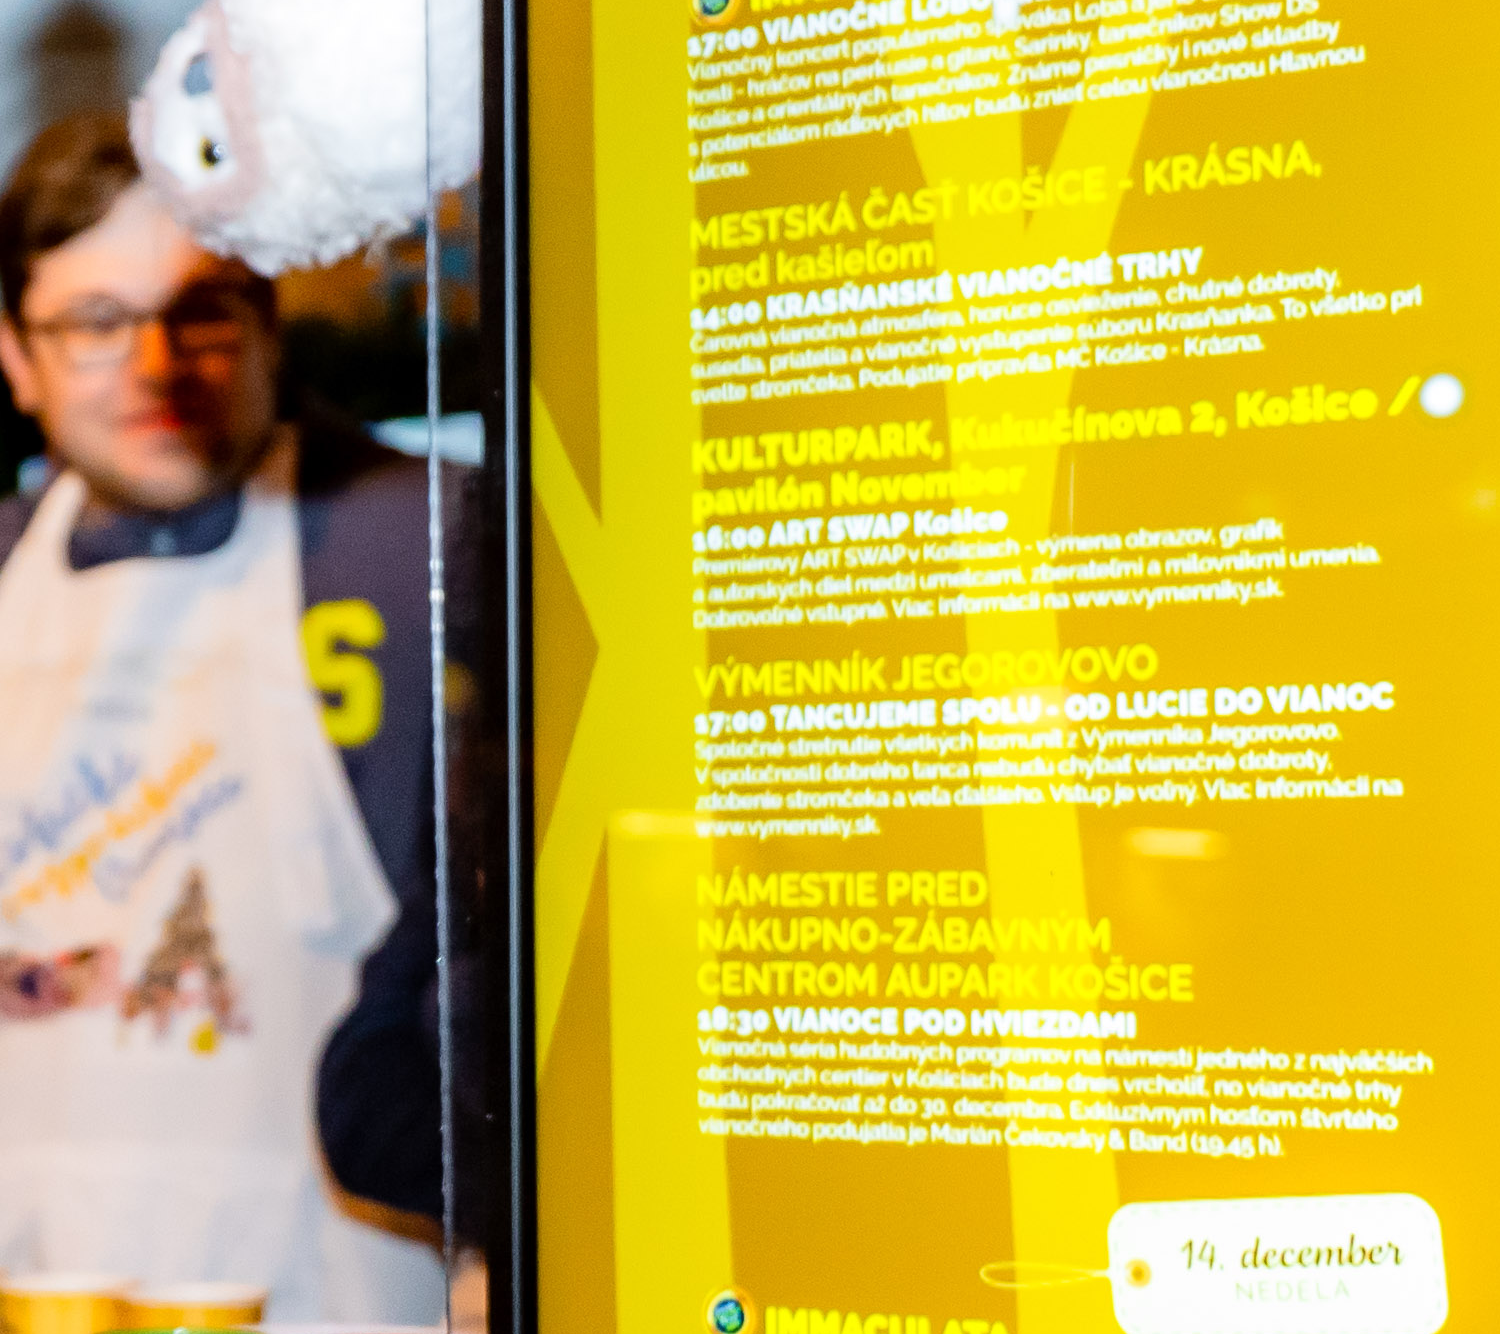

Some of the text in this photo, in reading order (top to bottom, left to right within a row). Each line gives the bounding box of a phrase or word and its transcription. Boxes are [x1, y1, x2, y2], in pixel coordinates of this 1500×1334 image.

[686, 26, 759, 57] 17:00
[691, 194, 848, 250] MESTSKÁ
[861, 180, 955, 229] ČASŤ
[969, 166, 1107, 214] KOŠICE
[1146, 141, 1320, 193] KRÁSNA,
[689, 247, 1203, 335] 14:00 KRASŇANSKÉ VIANOČNÉ TRHY
[690, 240, 933, 302] pred kašieľom
[691, 421, 944, 473] KULTURPARK,
[948, 407, 1183, 451] Kukučínova
[1190, 400, 1228, 437] 2,
[1236, 385, 1379, 428] Košice
[692, 463, 1026, 525] pavilón November
[692, 507, 1008, 552] 16:00 ART SWAP Košice
[693, 645, 1158, 697] VÝMENNÍK JEGOROVOVO
[694, 710, 766, 737] 17:00
[770, 699, 936, 731] TANCUJEME
[942, 695, 1042, 726] SPOLU
[1064, 692, 1110, 721] OD
[1116, 688, 1207, 719] LUCIE
[1214, 687, 1263, 716] DO
[1267, 681, 1393, 713] VIANOC
[698, 869, 985, 908] NÁMESTIE PRED
[696, 913, 1112, 953] NÁKUPNO-ZÁBAVNÝM
[697, 957, 1194, 1002] CENTROM AUPARK KOŠICE
[697, 1005, 1137, 1039] 18:30 VIANOCE POD HVIEZDAMI
[1180, 1234, 1405, 1273] 14. december
